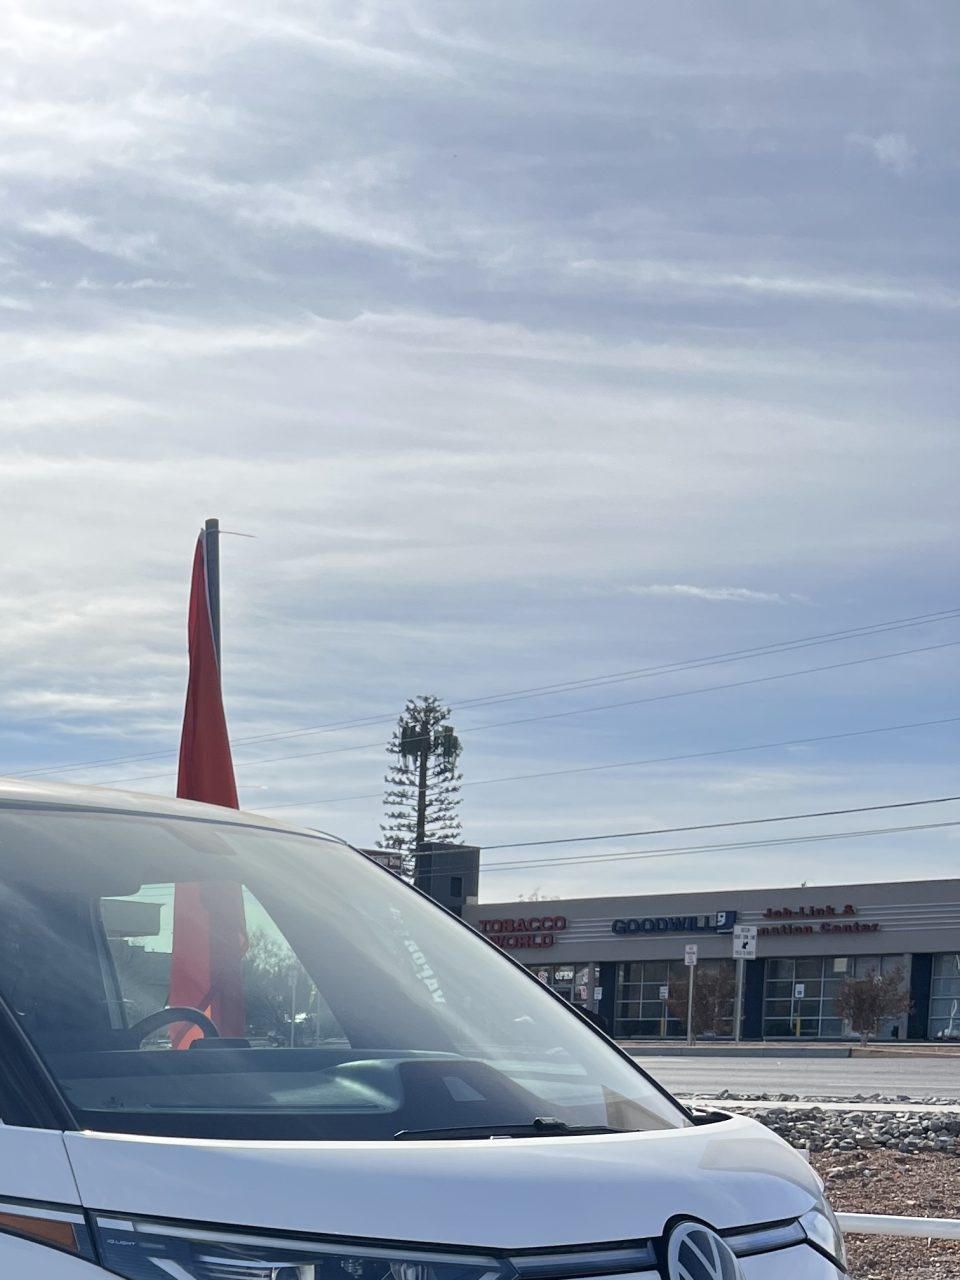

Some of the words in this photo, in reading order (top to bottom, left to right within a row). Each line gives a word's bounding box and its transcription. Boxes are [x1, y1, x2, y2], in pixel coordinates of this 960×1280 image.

[843, 903, 855, 915] &
[478, 916, 567, 933] TOBACCO
[612, 917, 716, 934] GOODWILL
[820, 920, 880, 934] Center
[489, 933, 555, 949] WORLD
[555, 971, 574, 980] OPEN
